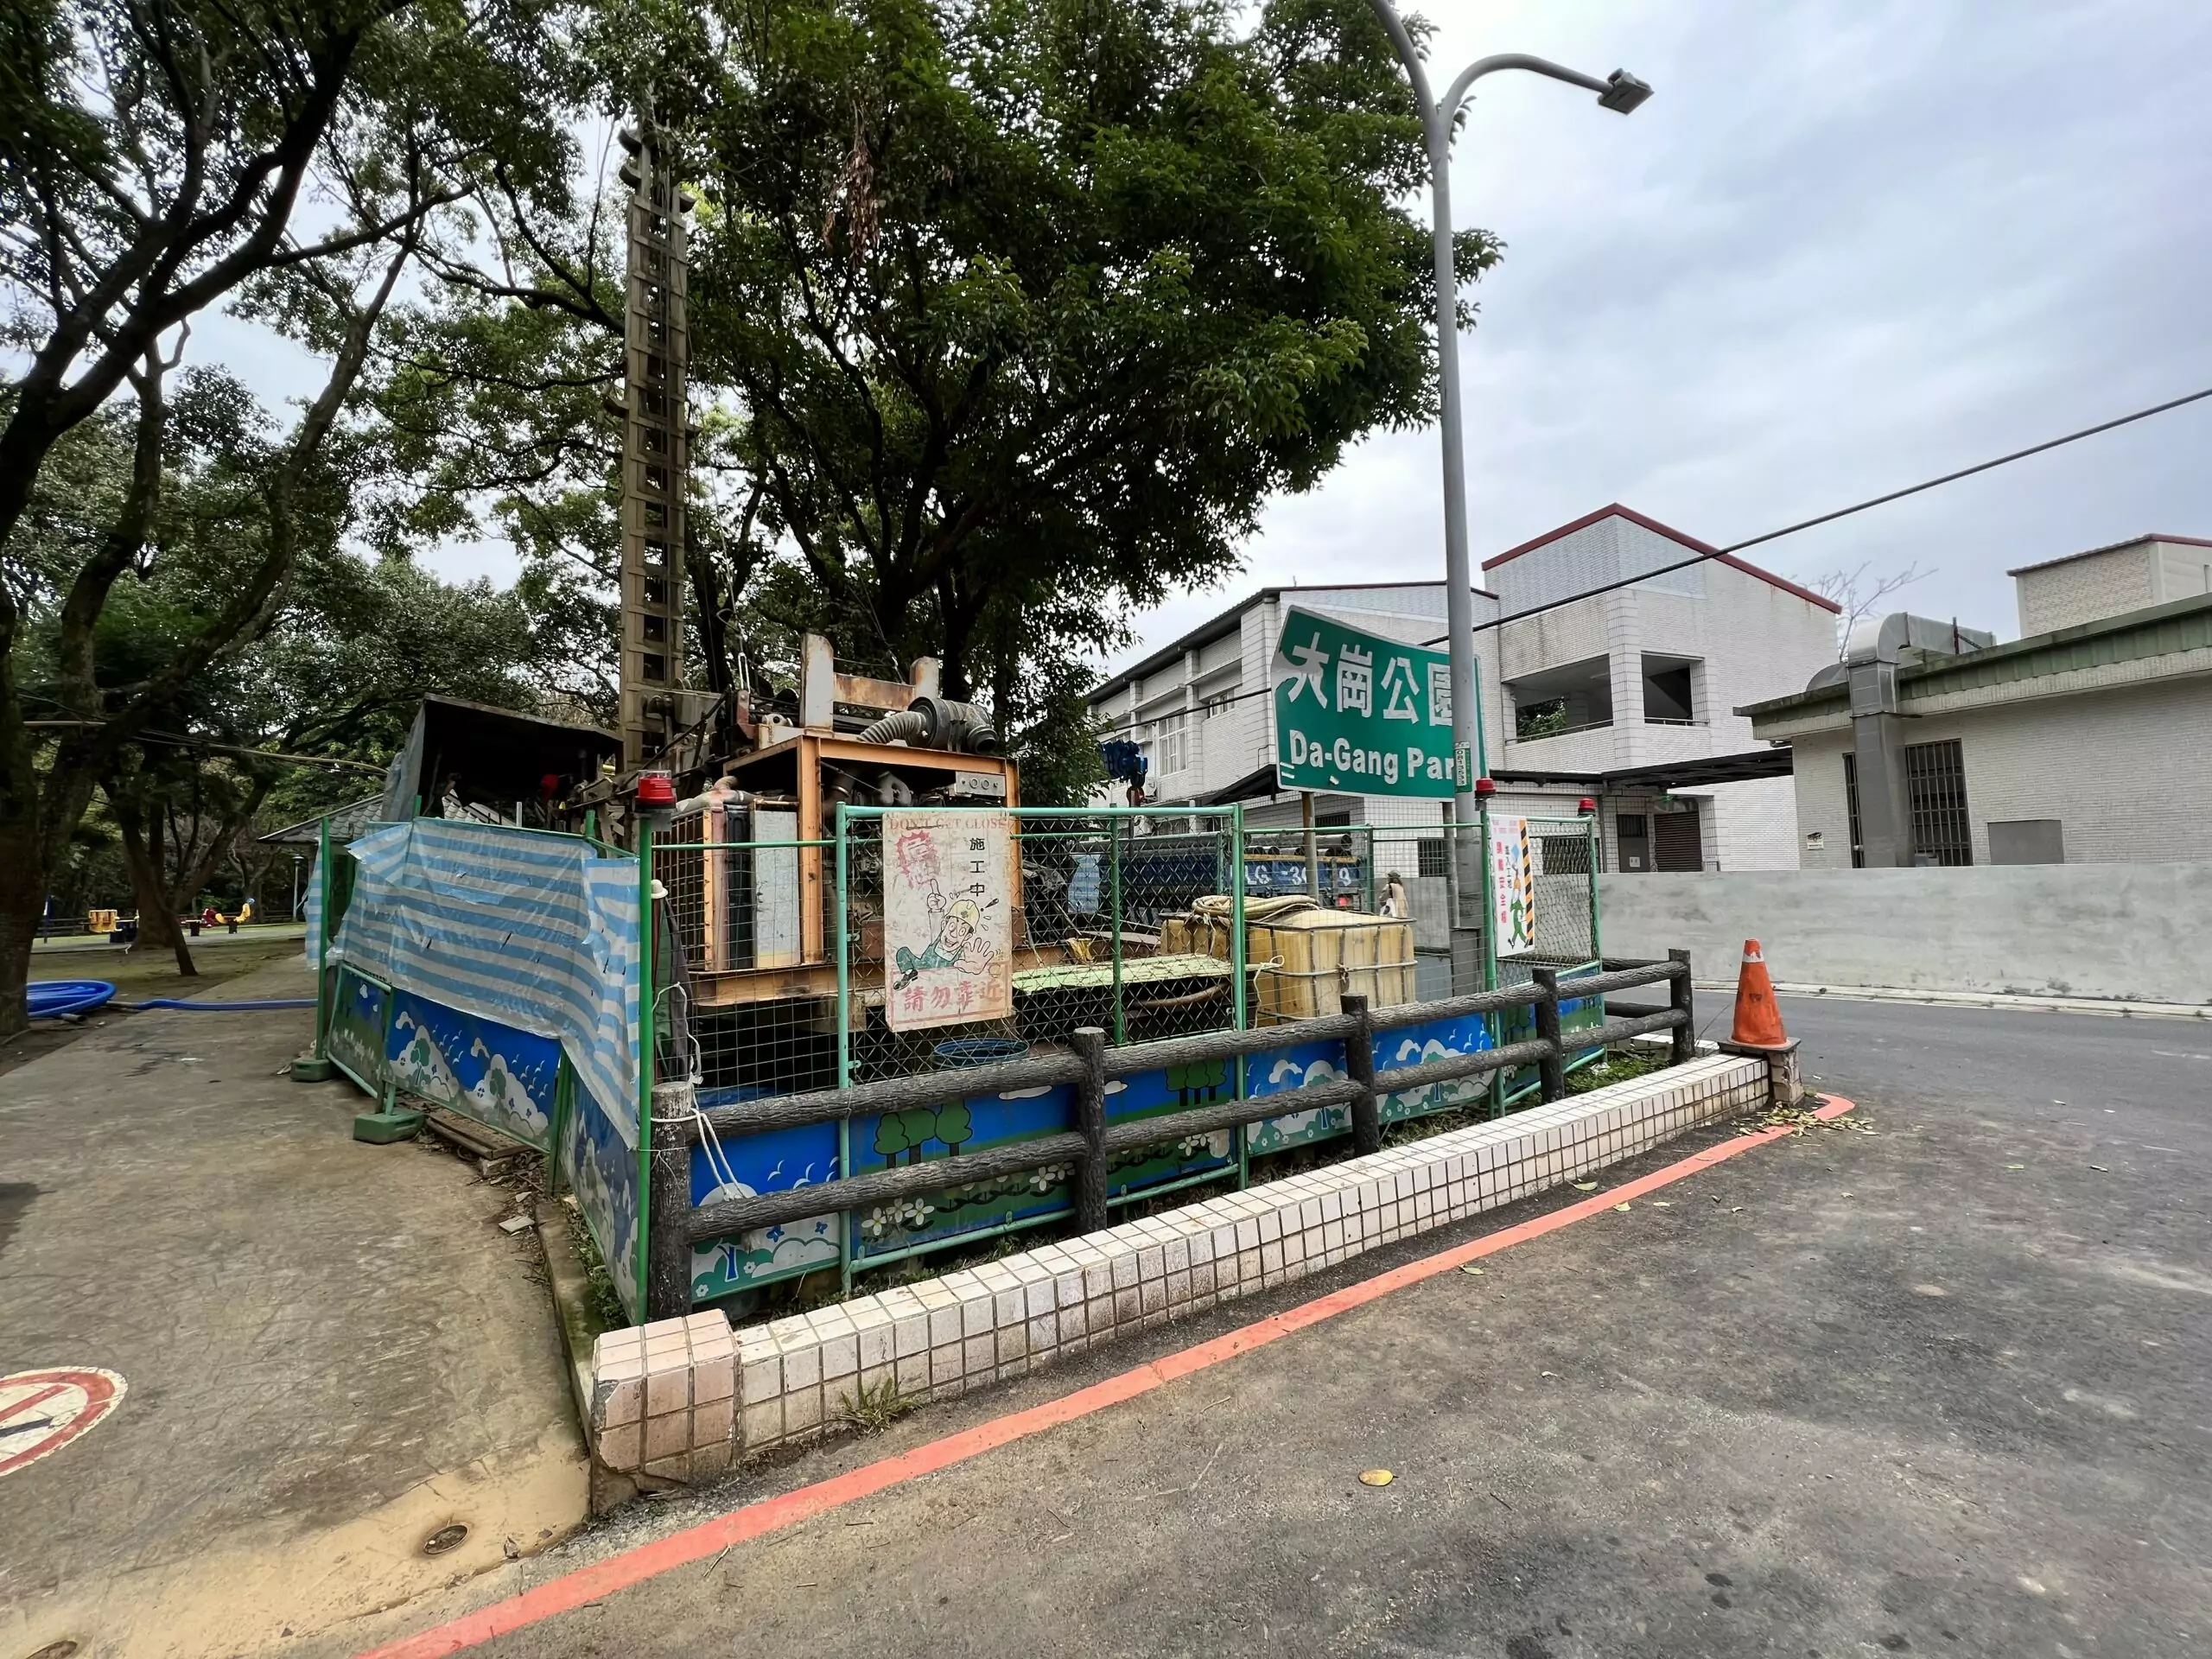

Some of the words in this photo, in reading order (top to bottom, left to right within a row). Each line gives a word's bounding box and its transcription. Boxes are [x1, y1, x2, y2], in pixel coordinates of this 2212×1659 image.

[1287, 631, 1453, 727] 大崗公園
[1289, 729, 1398, 785] Da-Gang
[1407, 747, 1453, 779] Par
[890, 818, 928, 830] DON'T
[936, 818, 962, 830] GET
[965, 818, 1007, 830] CLOSE
[969, 837, 985, 897] 施工中
[904, 979, 1003, 1013] 請勿靠近
